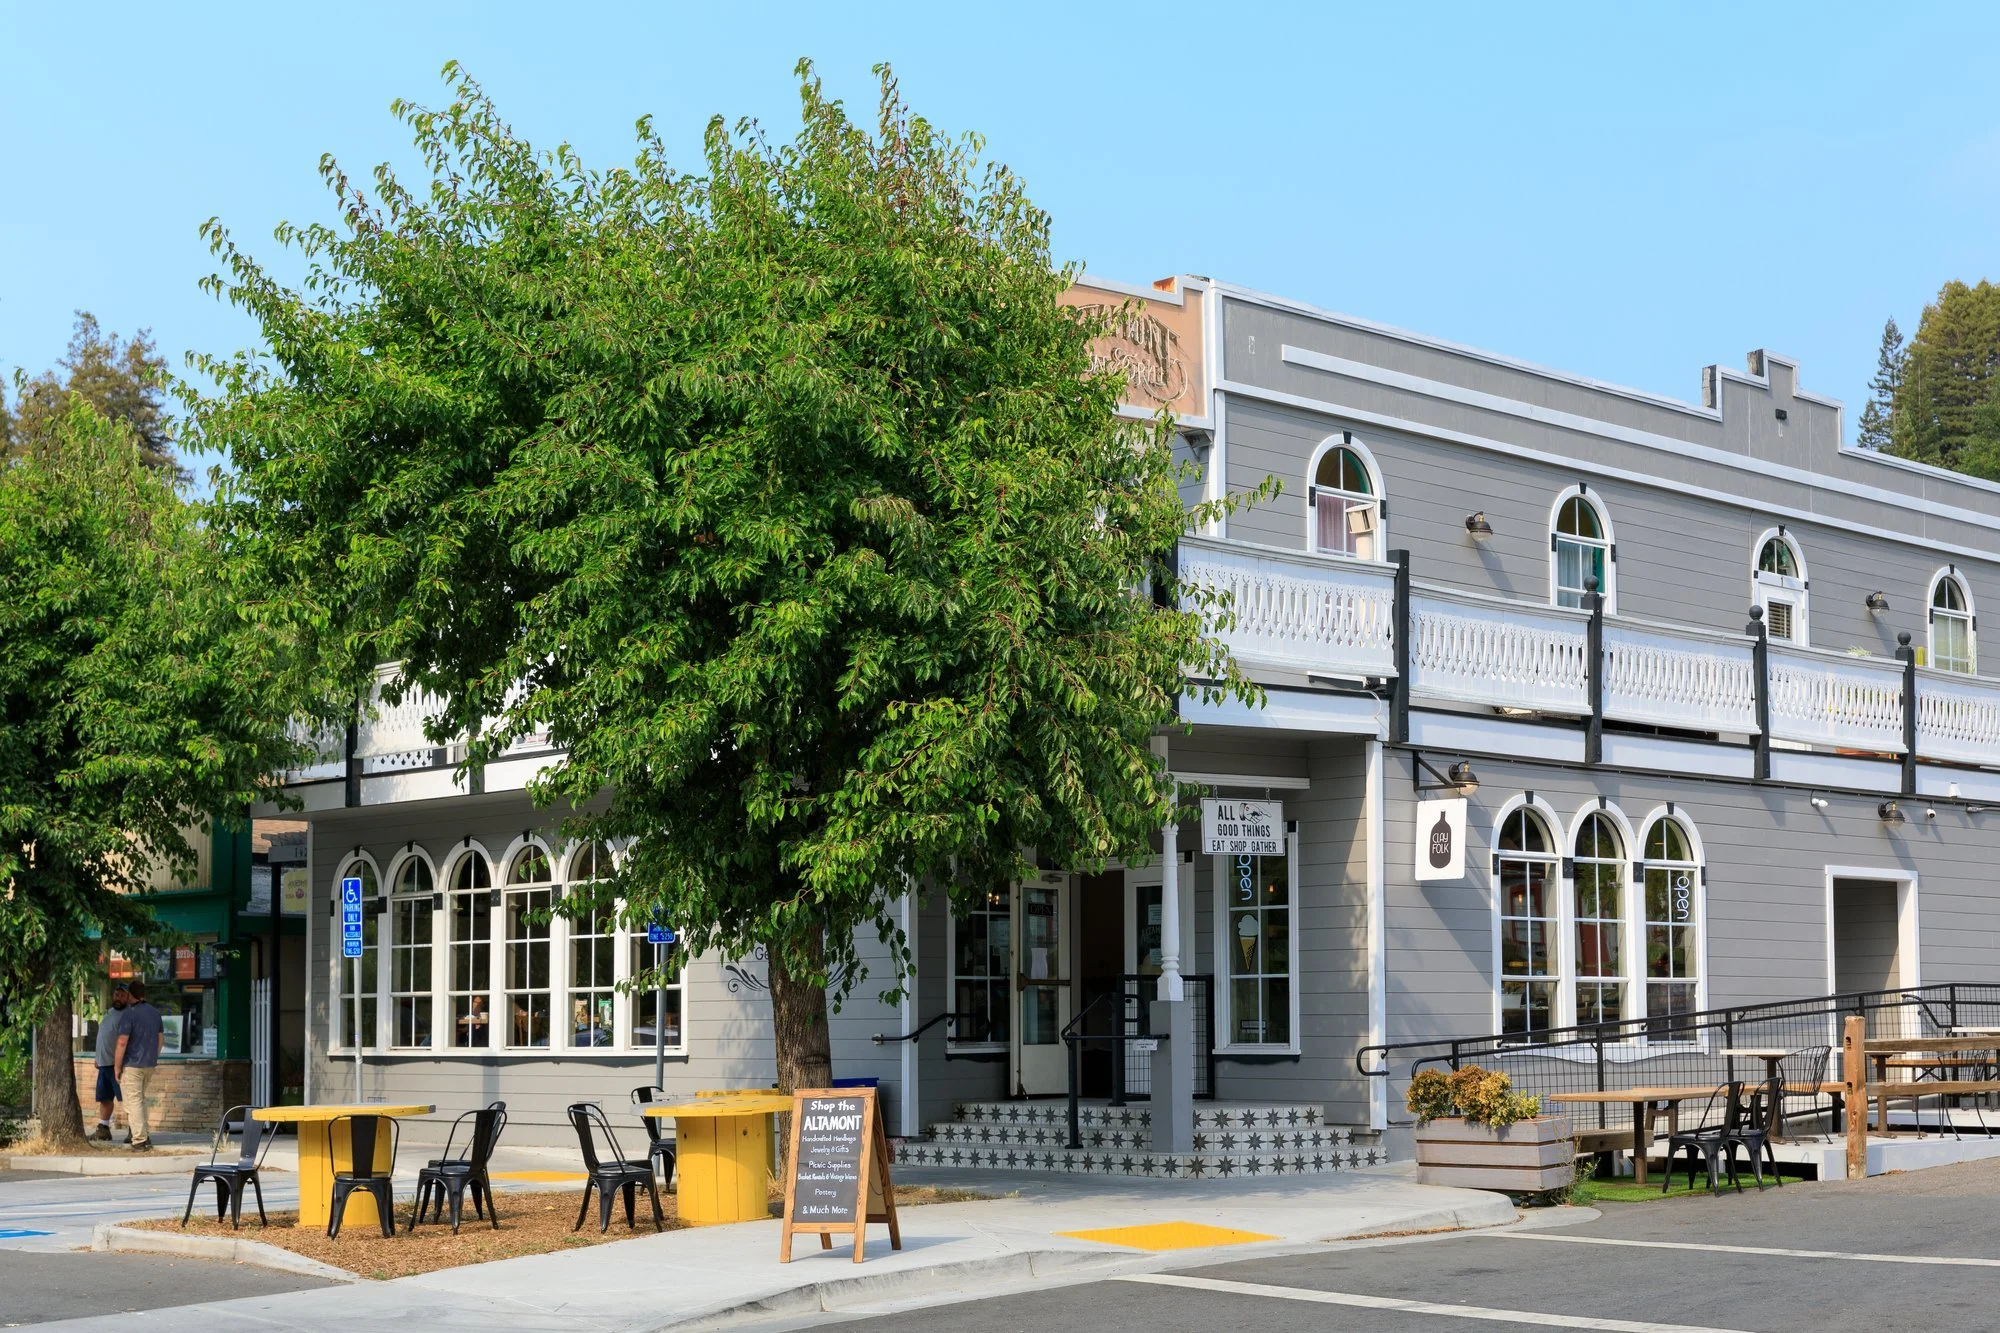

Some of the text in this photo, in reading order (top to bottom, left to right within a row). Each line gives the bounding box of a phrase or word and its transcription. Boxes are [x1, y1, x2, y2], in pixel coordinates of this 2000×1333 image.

[1218, 805, 1235, 821] ALL
[1217, 823, 1271, 838] GOOD THINGS
[1432, 832, 1449, 843] CLAY
[1212, 840, 1277, 853] EAT SHOP GATHER
[1431, 843, 1449, 854] FOLK
[1236, 854, 1253, 901] open
[1673, 876, 1690, 920] open
[344, 903, 360, 912] PARKING
[347, 913, 358, 922] ONLY
[810, 1100, 856, 1113] Shop the
[803, 1115, 862, 1131] ALTAMONT
[810, 1145, 831, 1156] Jewelry
[835, 1144, 850, 1153] Gifts
[808, 1160, 852, 1172] Picnic Supplies
[814, 1188, 837, 1198] Pottery
[802, 1204, 849, 1214] & Much More
